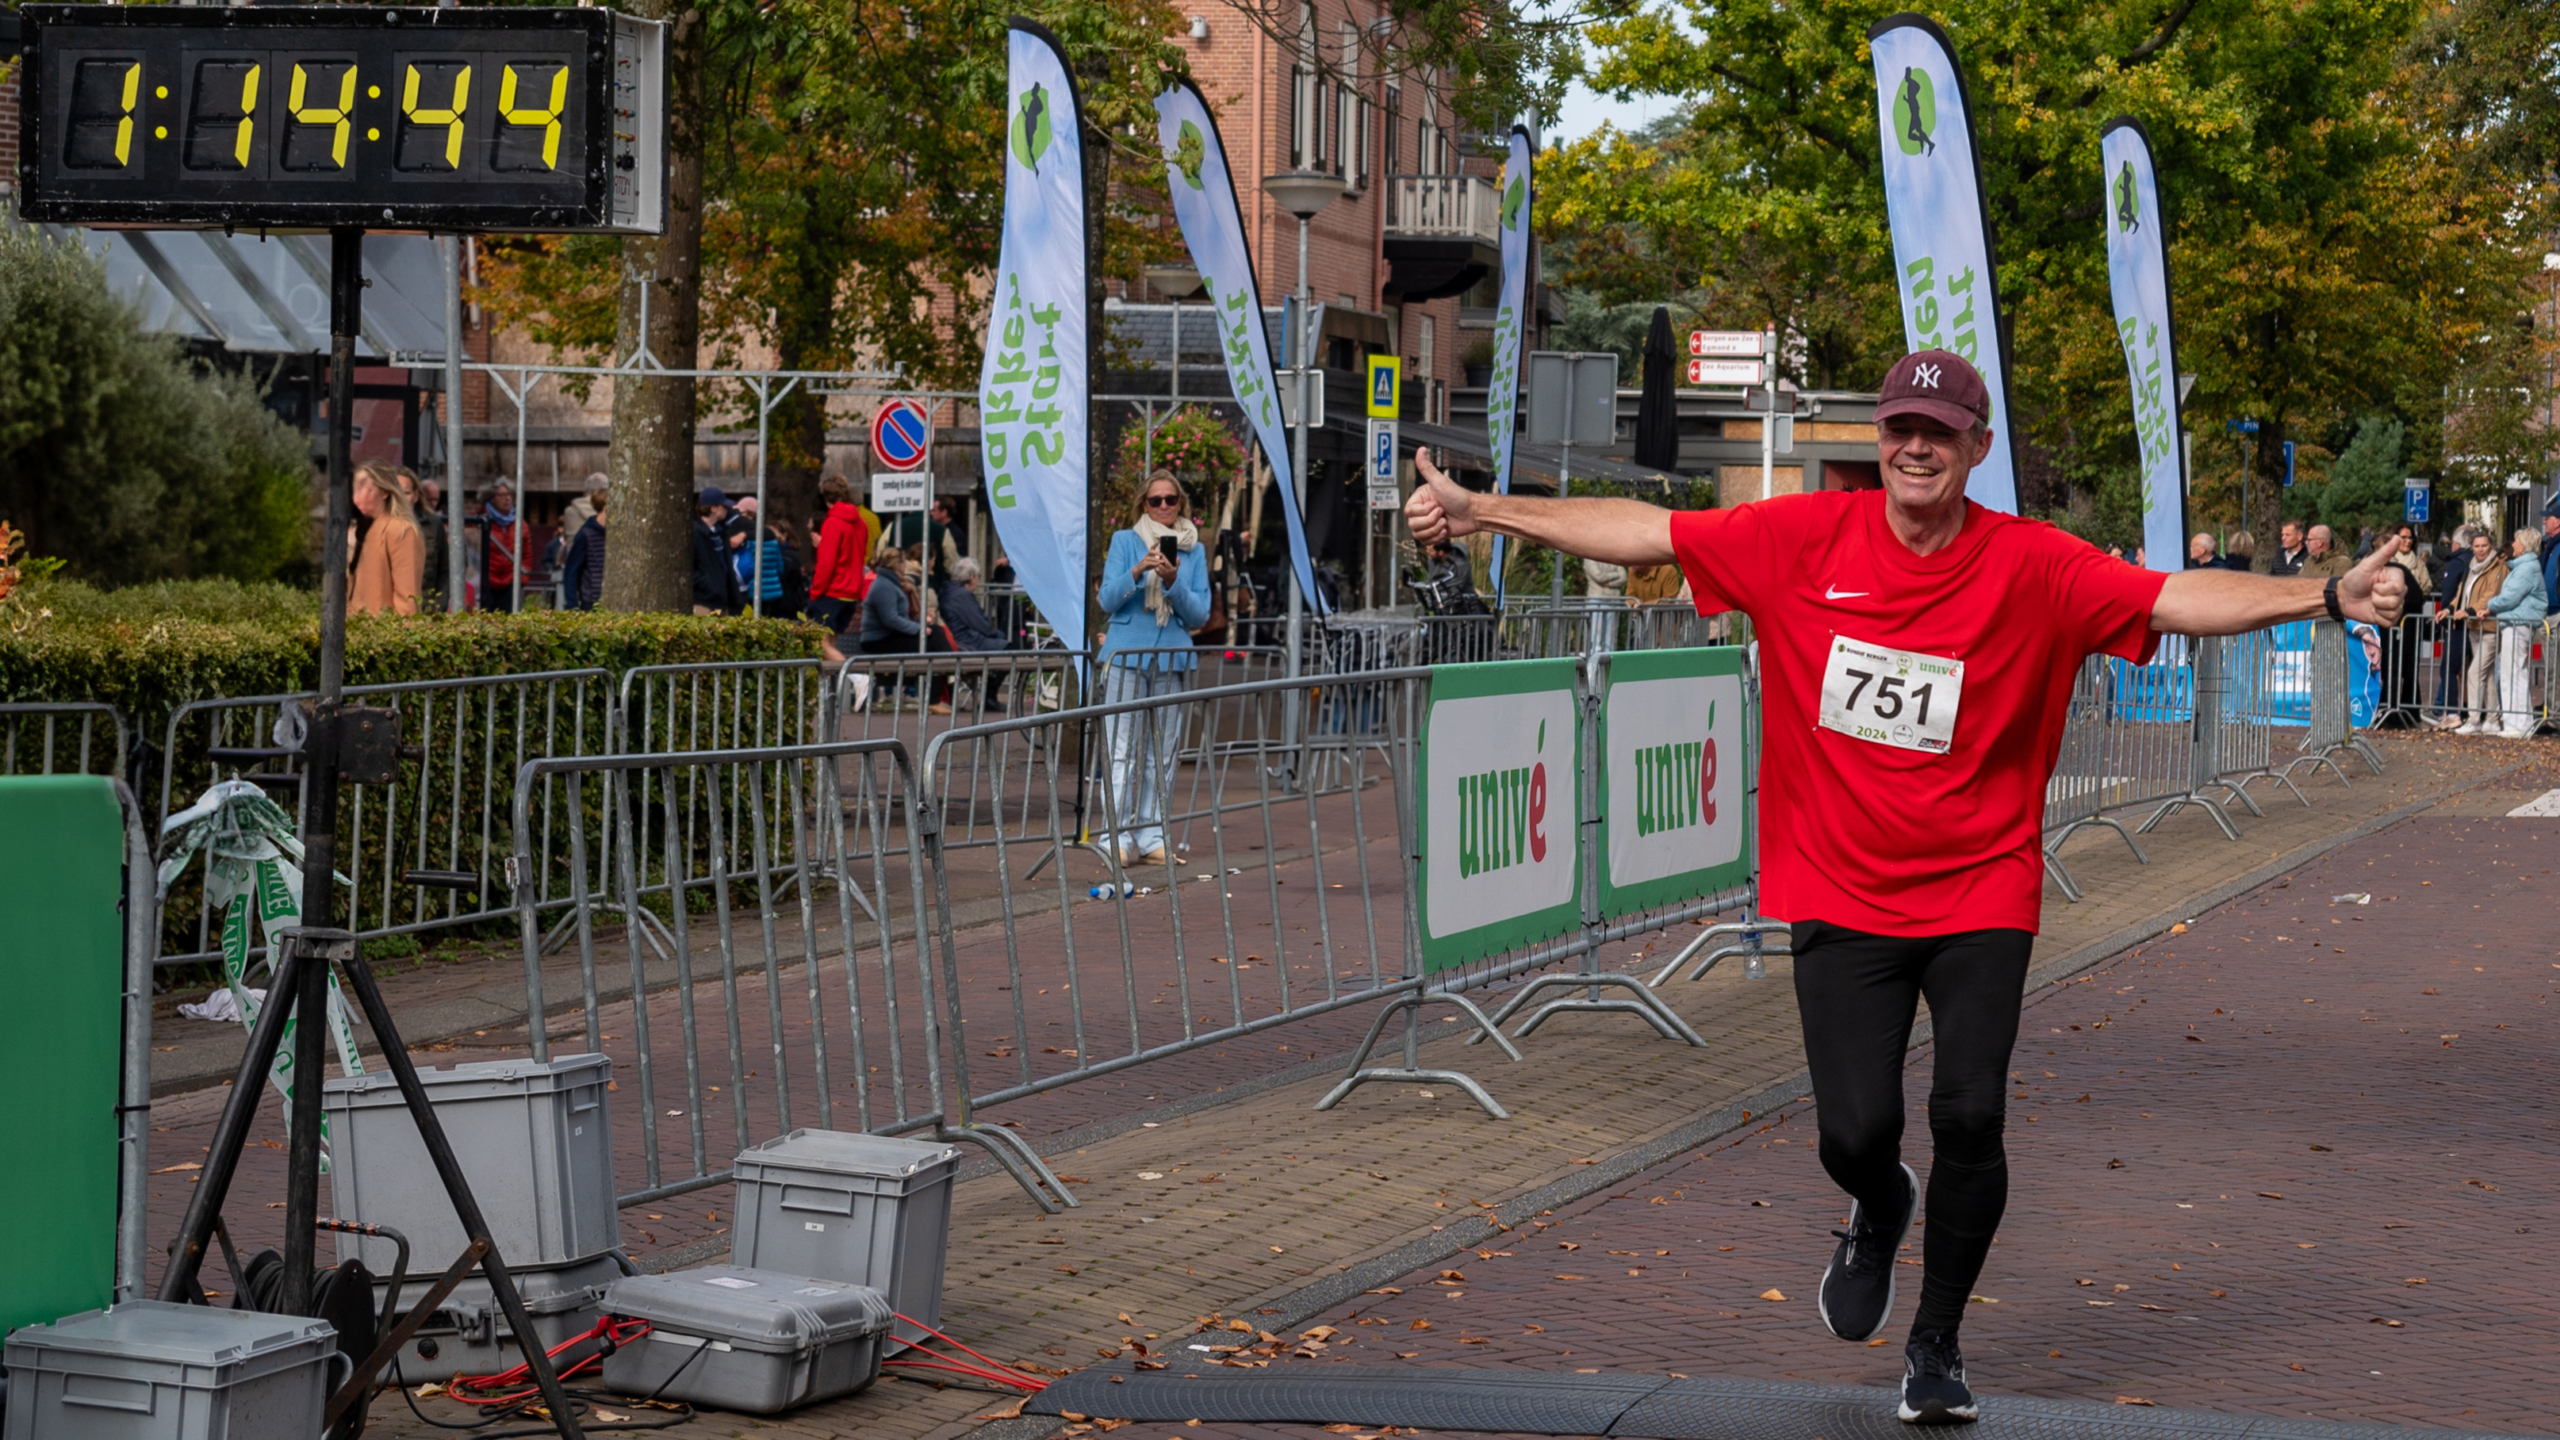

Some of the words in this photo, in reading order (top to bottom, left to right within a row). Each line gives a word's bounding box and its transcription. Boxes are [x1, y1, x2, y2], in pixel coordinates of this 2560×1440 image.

[114, 61, 570, 170] 1:14:44
[1703, 335, 1726, 343] Bergen
[1716, 363, 1751, 371] Aquarium
[1845, 667, 1933, 726] 751
[1856, 725, 1888, 741] 2024
[1635, 699, 1717, 838] univé
[1458, 717, 1547, 880] univé
